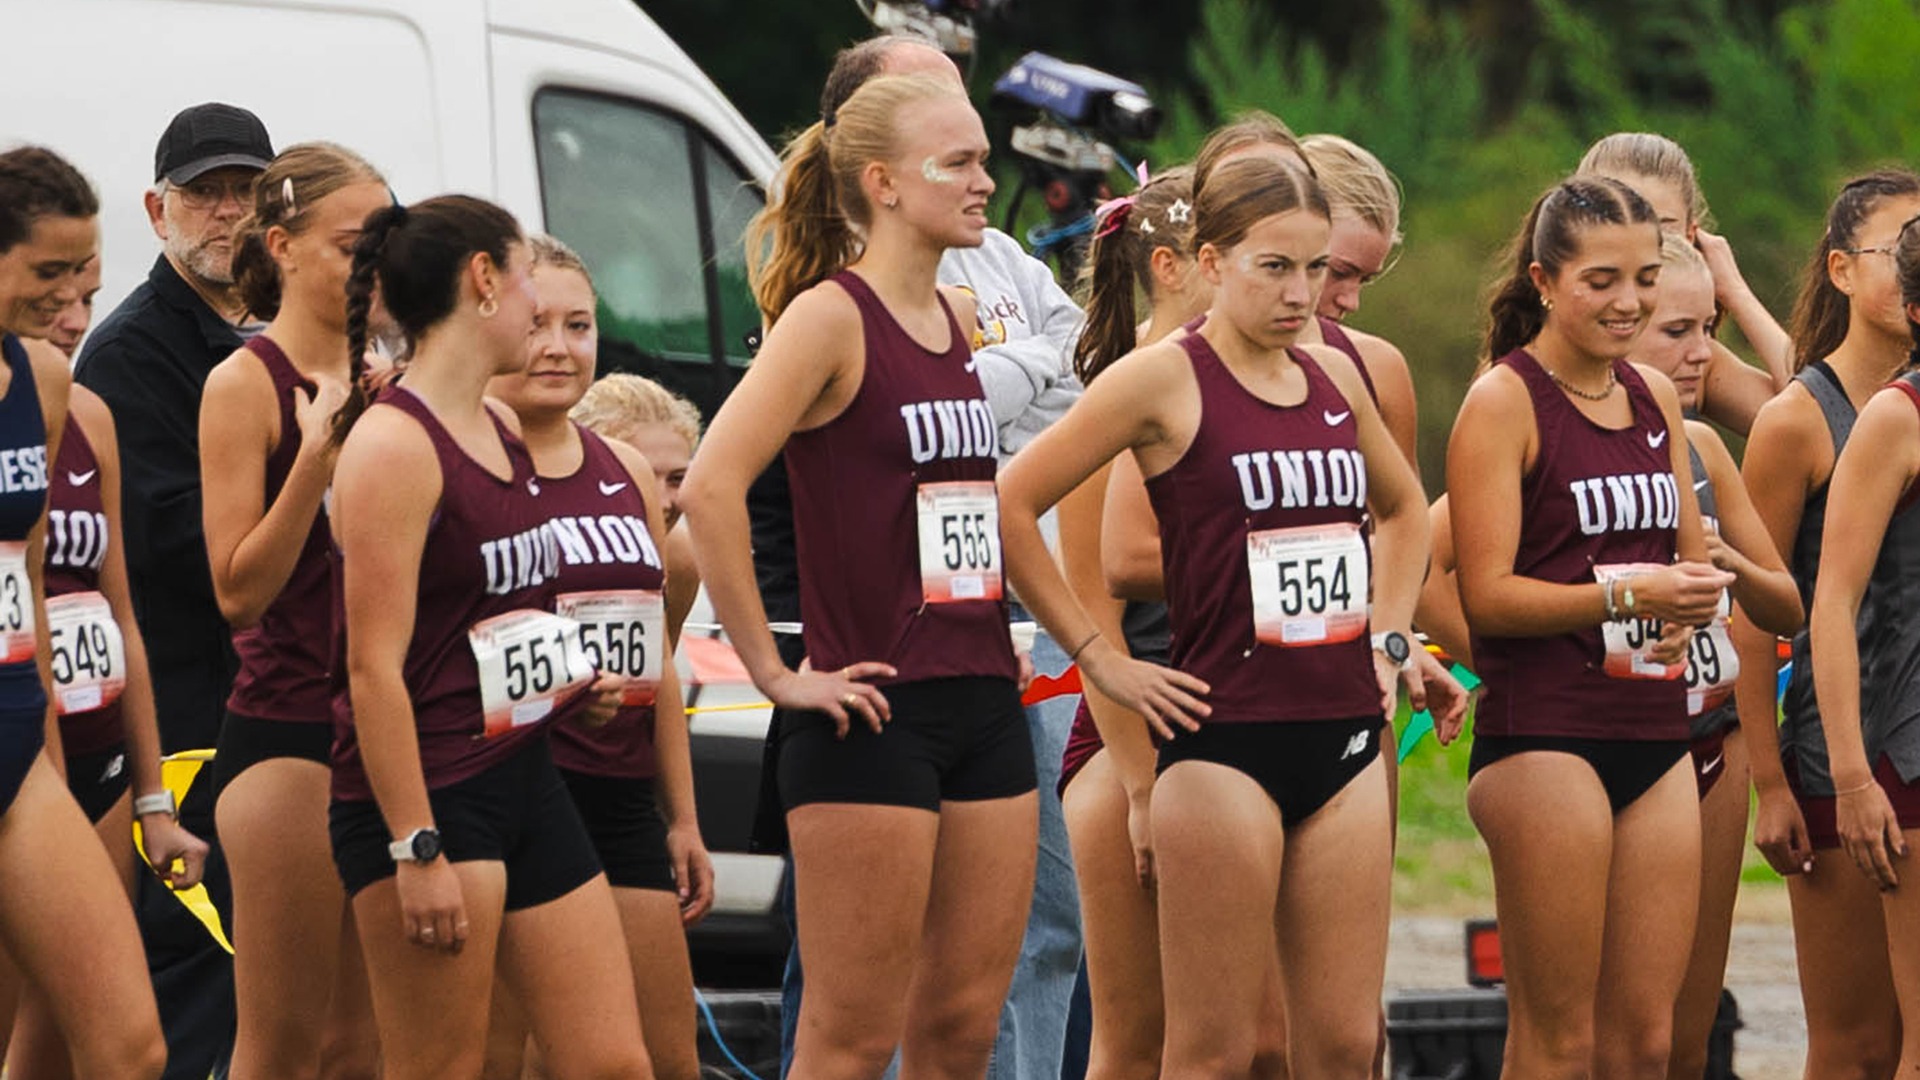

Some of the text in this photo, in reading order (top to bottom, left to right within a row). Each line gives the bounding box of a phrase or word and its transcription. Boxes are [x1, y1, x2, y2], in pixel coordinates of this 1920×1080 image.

[0, 445, 49, 493] ESE
[1570, 472, 1679, 535] UNIO
[44, 509, 108, 569] IO
[481, 523, 560, 595] UNIO
[549, 515, 662, 570] NION
[942, 514, 991, 570] 555
[0, 573, 22, 631] 3
[1278, 555, 1351, 616] 554
[50, 623, 111, 685] 549
[579, 621, 645, 678] 556
[1625, 614, 1664, 650] 54
[504, 629, 573, 701] 551
